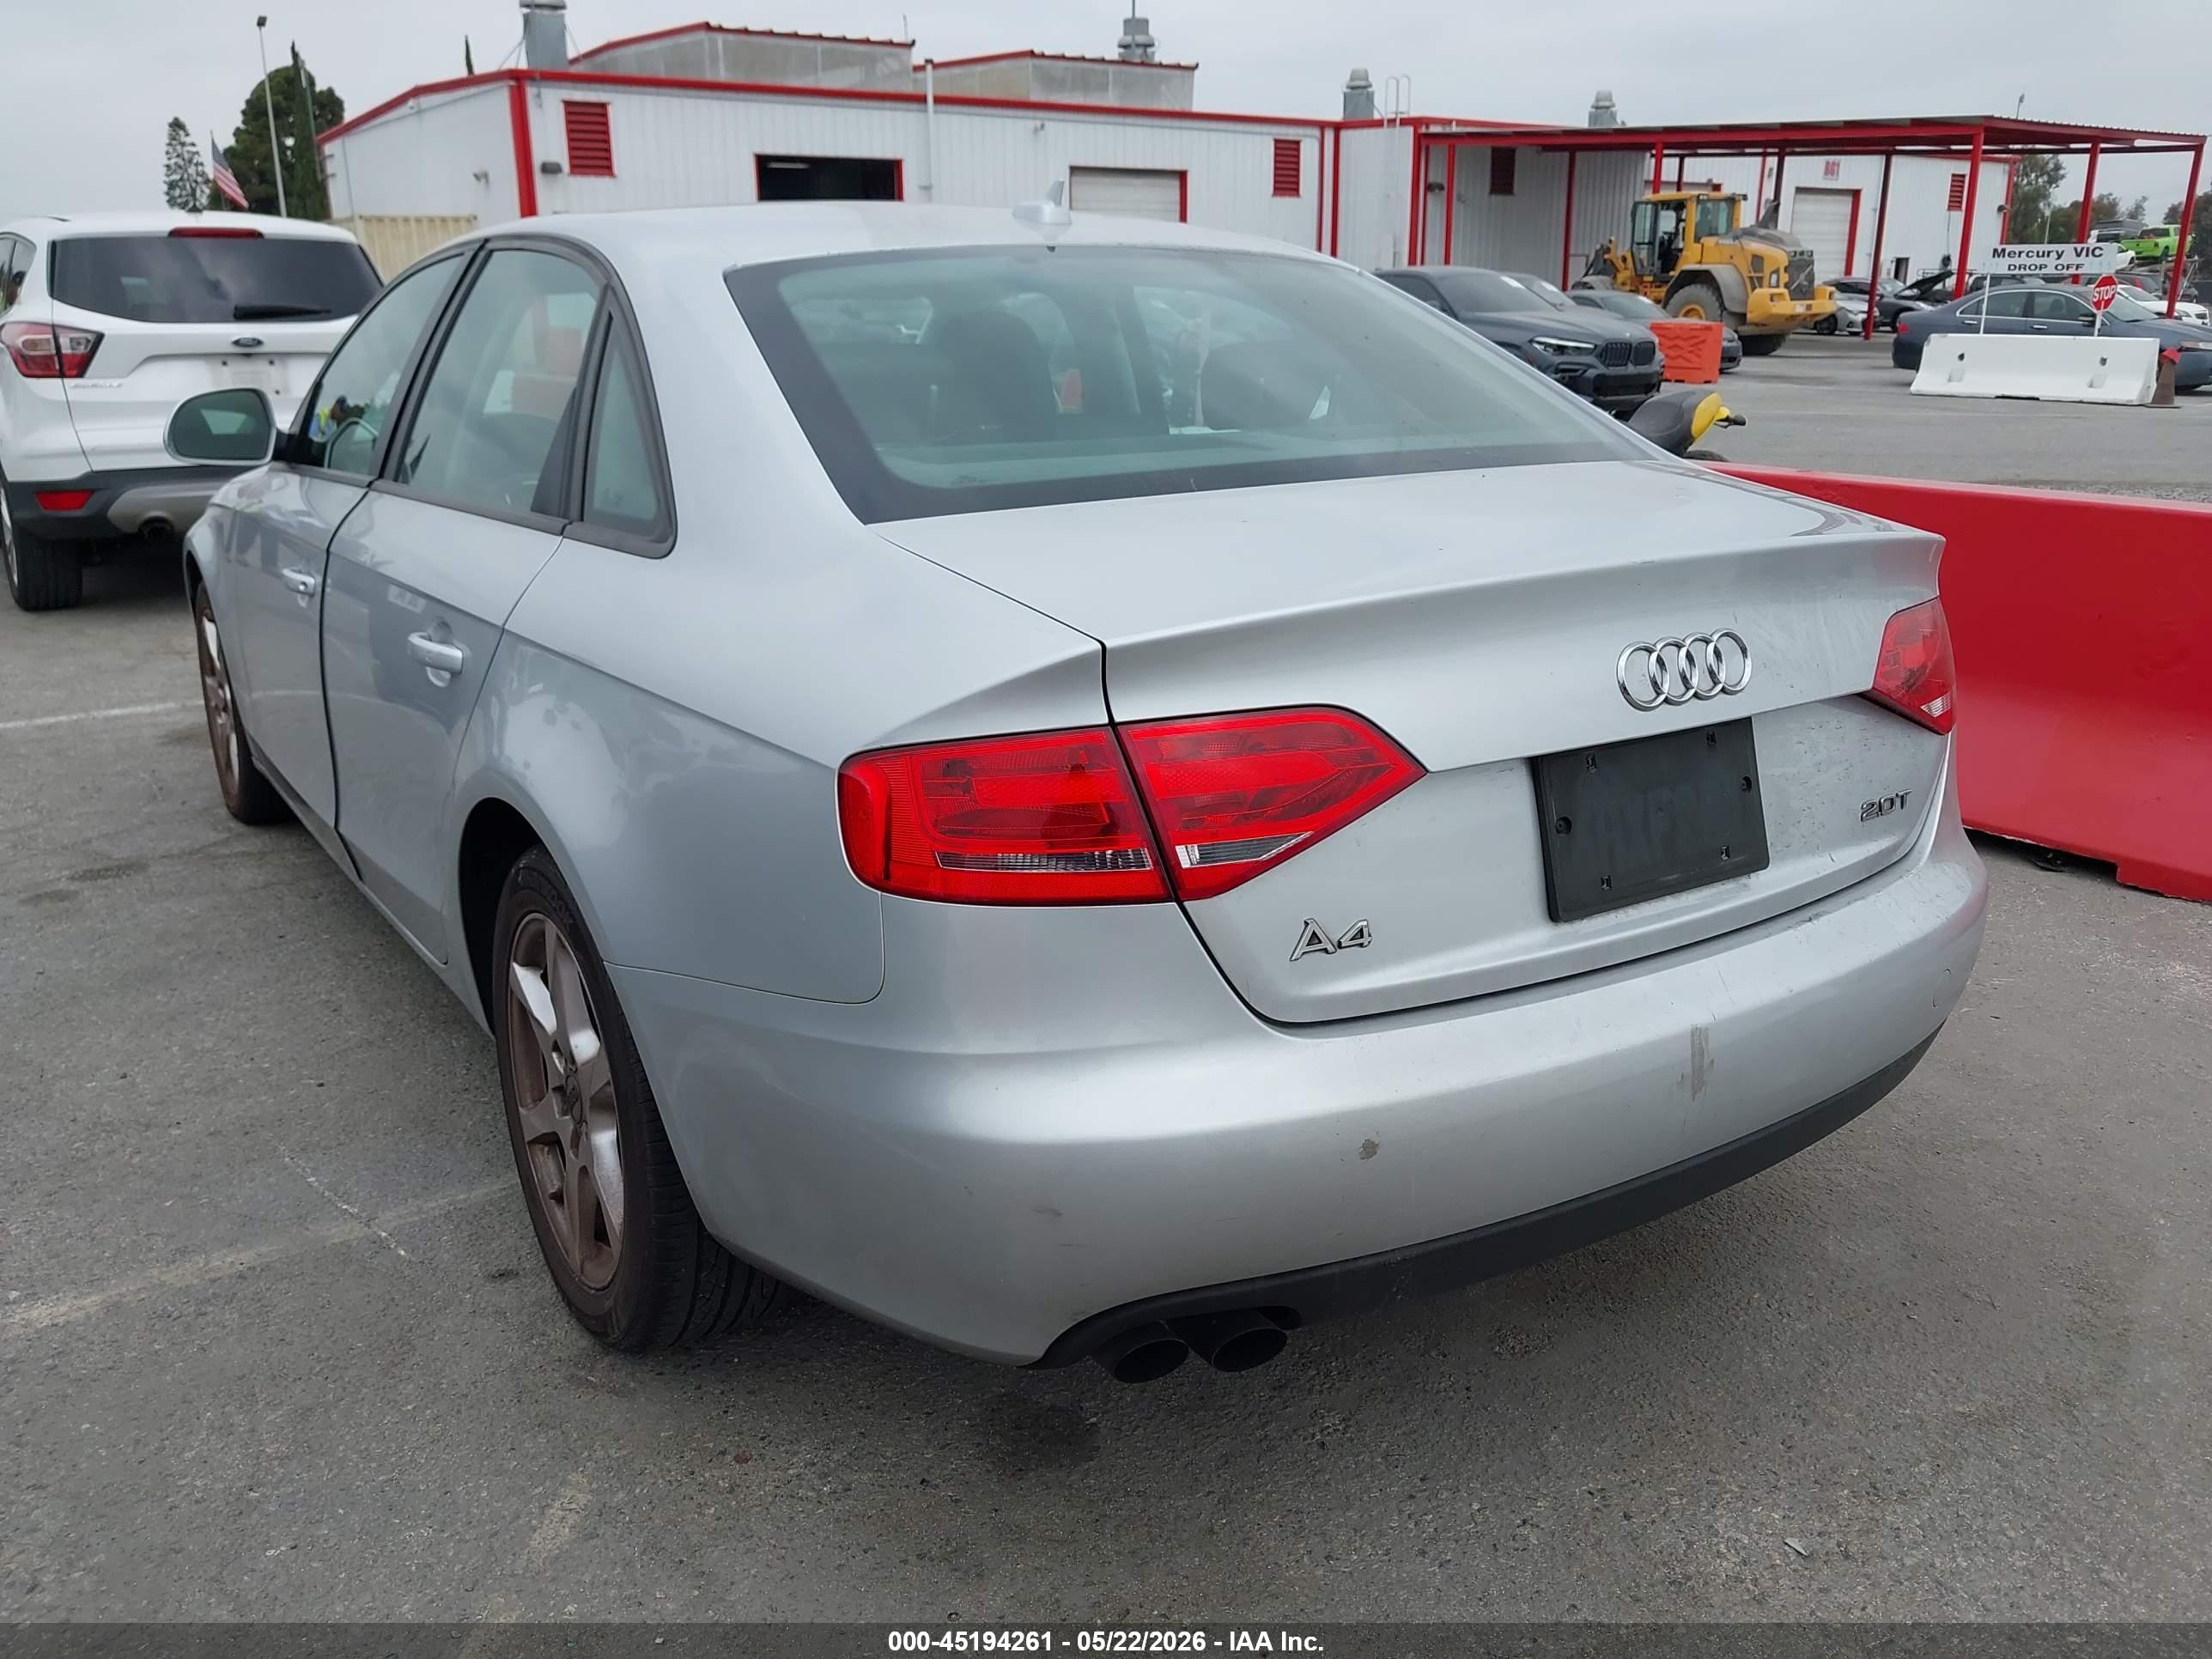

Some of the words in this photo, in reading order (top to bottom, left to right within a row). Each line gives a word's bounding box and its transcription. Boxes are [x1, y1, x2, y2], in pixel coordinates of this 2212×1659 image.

[1992, 247, 2064, 260] Mercury
[2074, 246, 2104, 258] VIC
[2054, 263, 2085, 271] OFF
[2093, 285, 2117, 302] STOP
[1289, 917, 1373, 962] A4
